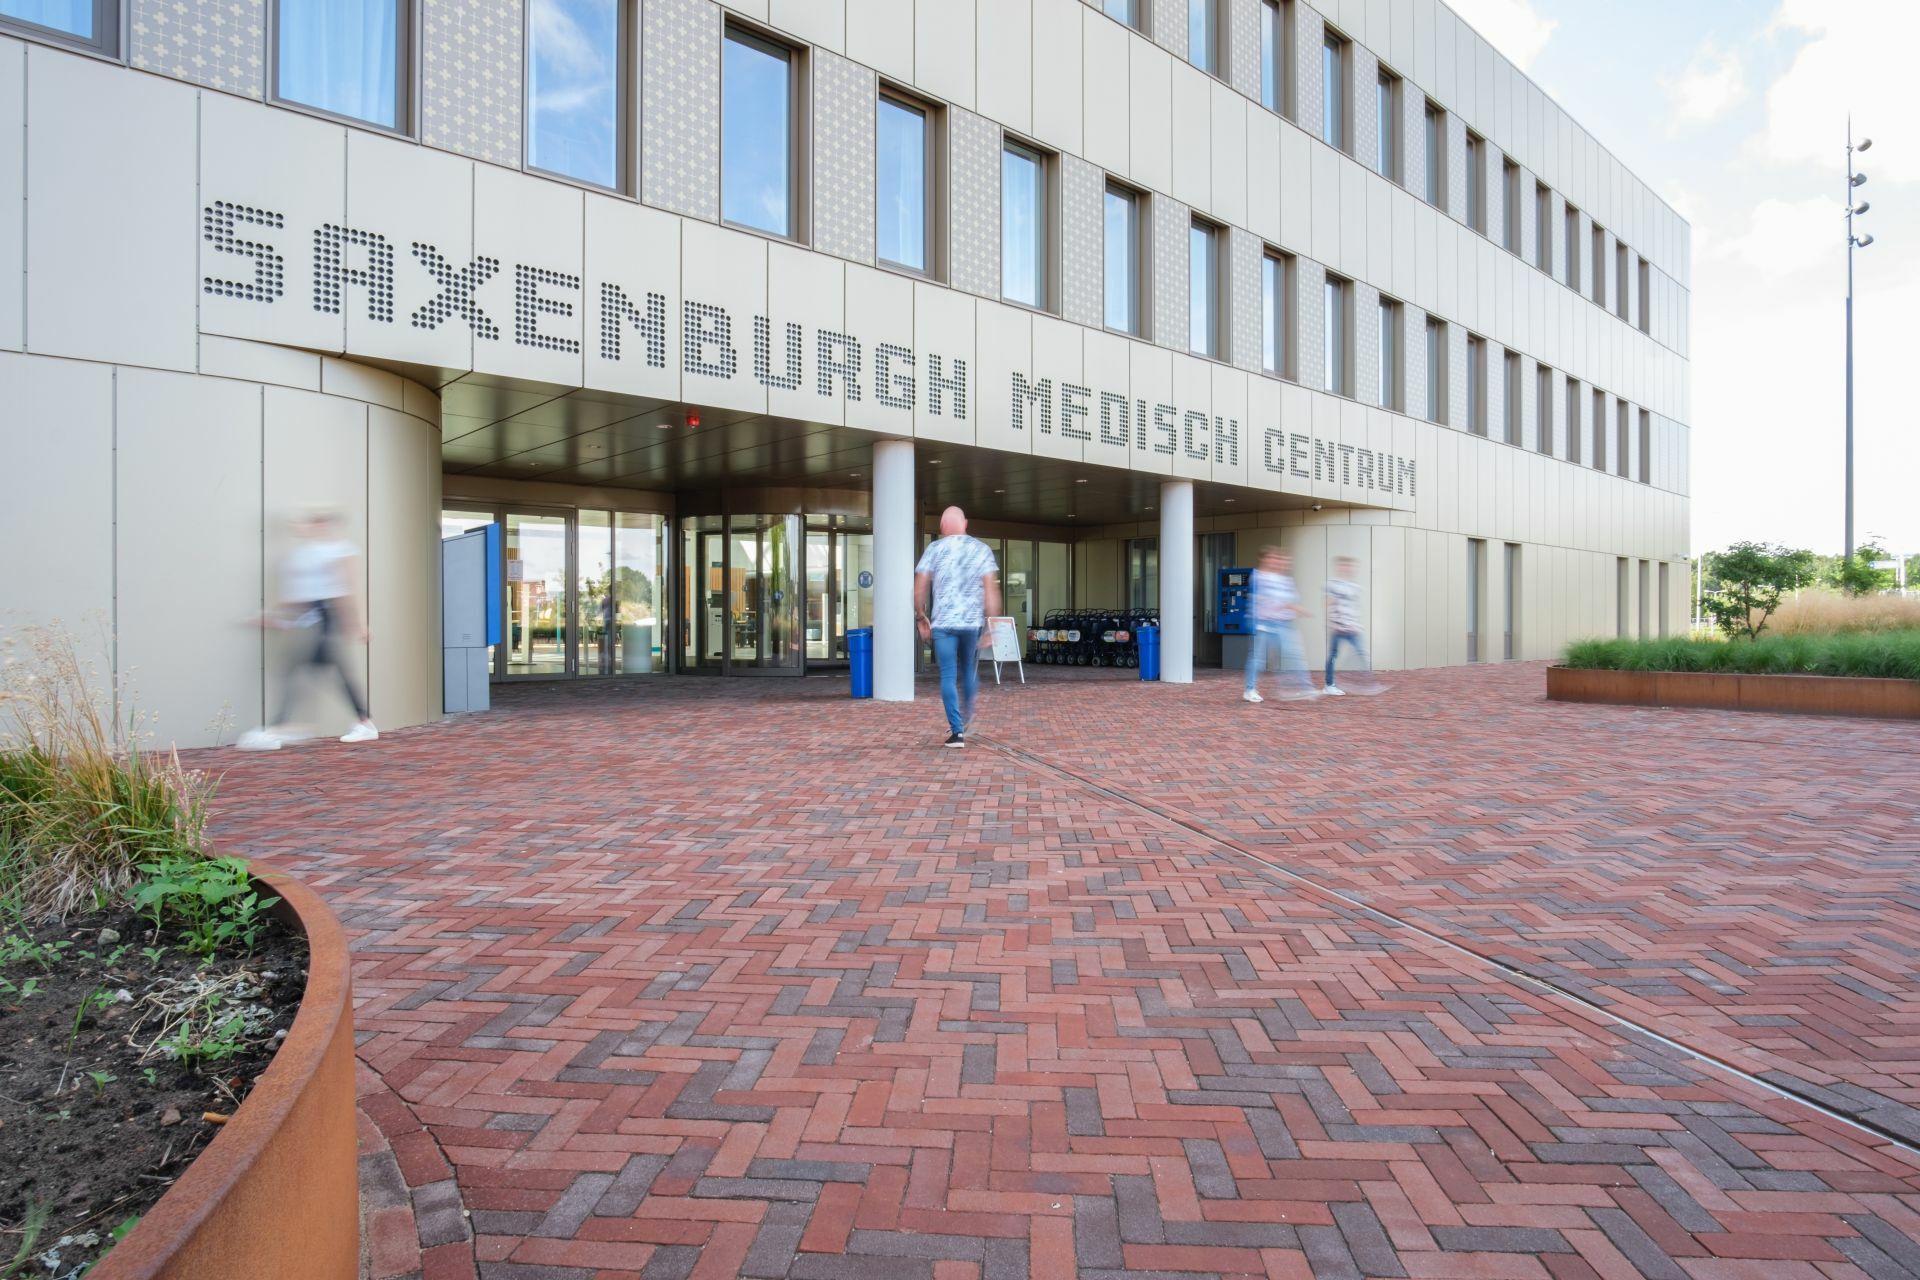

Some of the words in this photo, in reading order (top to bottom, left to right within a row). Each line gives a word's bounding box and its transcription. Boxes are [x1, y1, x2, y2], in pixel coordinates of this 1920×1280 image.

[204, 200, 967, 419] SAXENBURGH
[1012, 371, 1238, 466] MEDISCH
[1264, 427, 1416, 497] CENTRUM
